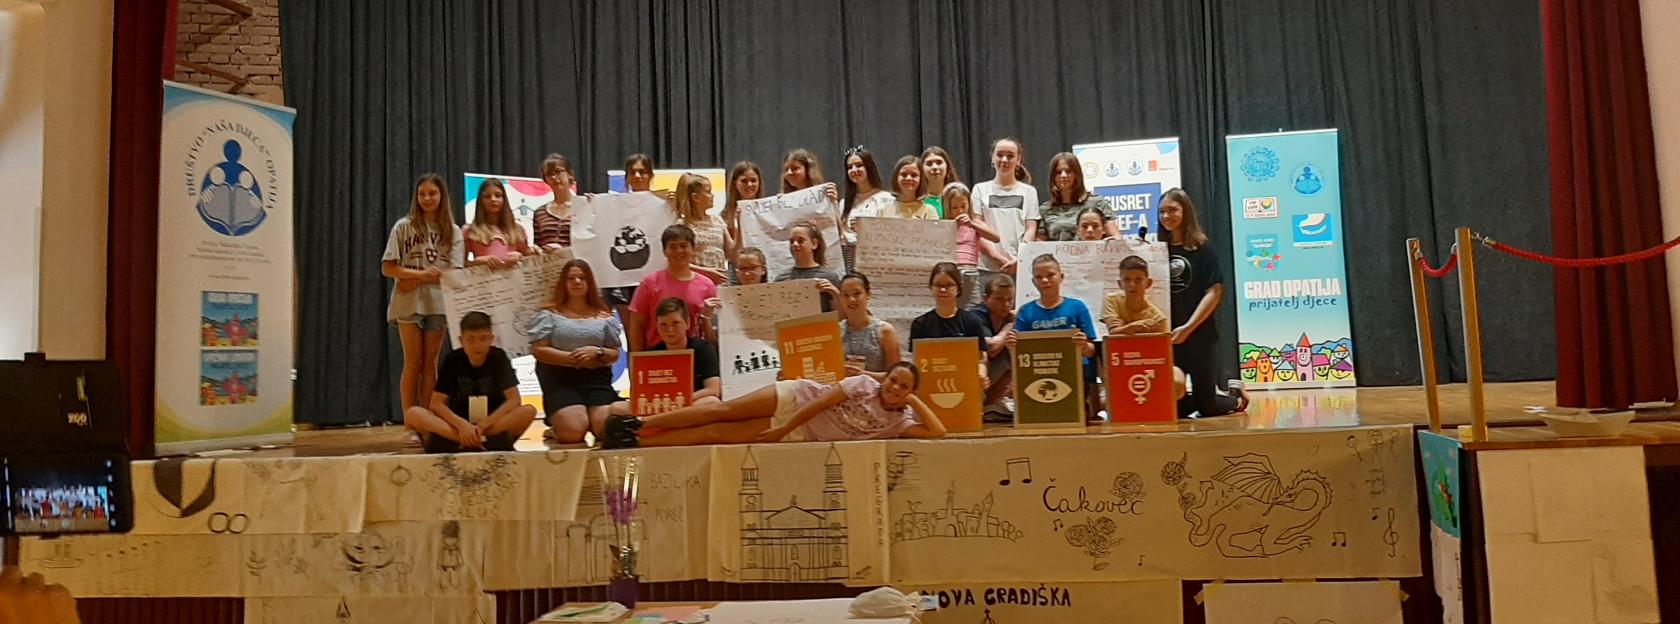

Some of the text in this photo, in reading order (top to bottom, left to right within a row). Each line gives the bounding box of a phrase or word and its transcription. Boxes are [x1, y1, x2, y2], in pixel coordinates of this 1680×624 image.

[184, 136, 204, 197] DRUŠTVO
[264, 159, 278, 209] OPATIJA
[1115, 214, 1148, 231] EF-A
[1243, 277, 1341, 299] GRAD OPATIJA
[1249, 294, 1337, 312] prijatelj djece
[784, 341, 794, 355] 11
[920, 358, 928, 372] 2
[1018, 353, 1031, 368] 13
[1111, 352, 1120, 366] 5
[638, 370, 644, 385] 1
[1043, 477, 1144, 516] Čakovec
[921, 583, 1071, 609] OVA GRADIŠKA
